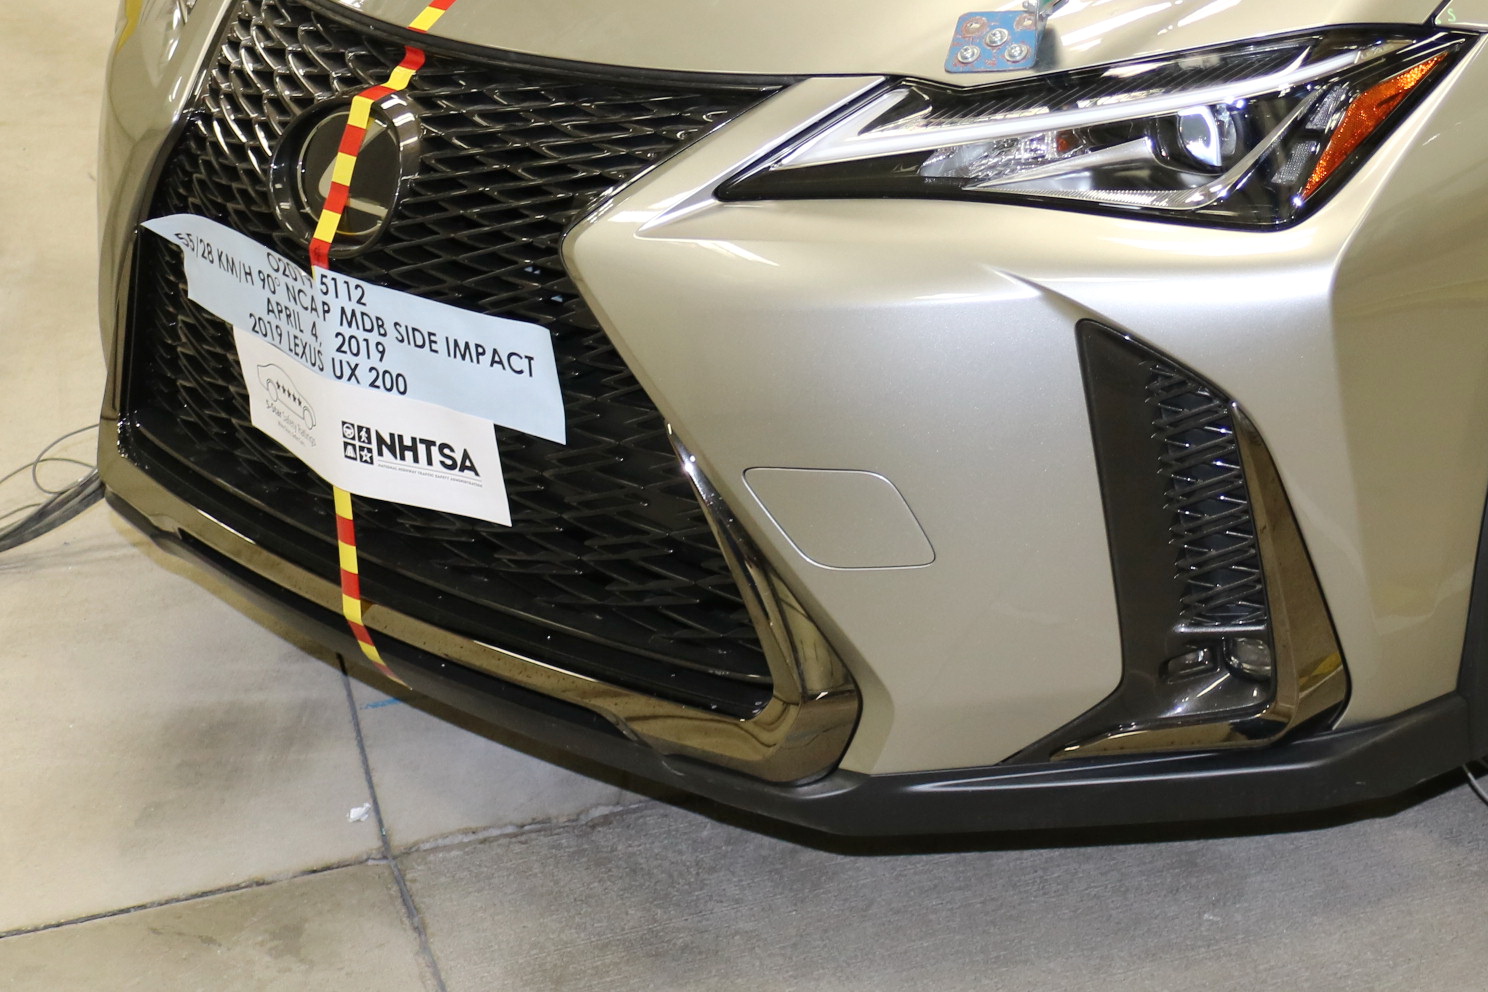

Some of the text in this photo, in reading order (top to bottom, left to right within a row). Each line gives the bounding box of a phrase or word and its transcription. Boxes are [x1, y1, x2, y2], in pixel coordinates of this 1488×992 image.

[174, 232, 214, 265] 55/28
[216, 247, 254, 287] KM/H
[285, 281, 331, 322] NCAP
[339, 306, 388, 338] MDB
[393, 321, 439, 354] SIDE
[445, 336, 535, 378] IMPACT
[266, 297, 304, 334] APRIL
[334, 331, 387, 363] 2019
[249, 313, 408, 396] 2019 LEXUS UX 200
[375, 428, 481, 478] NHTSA
